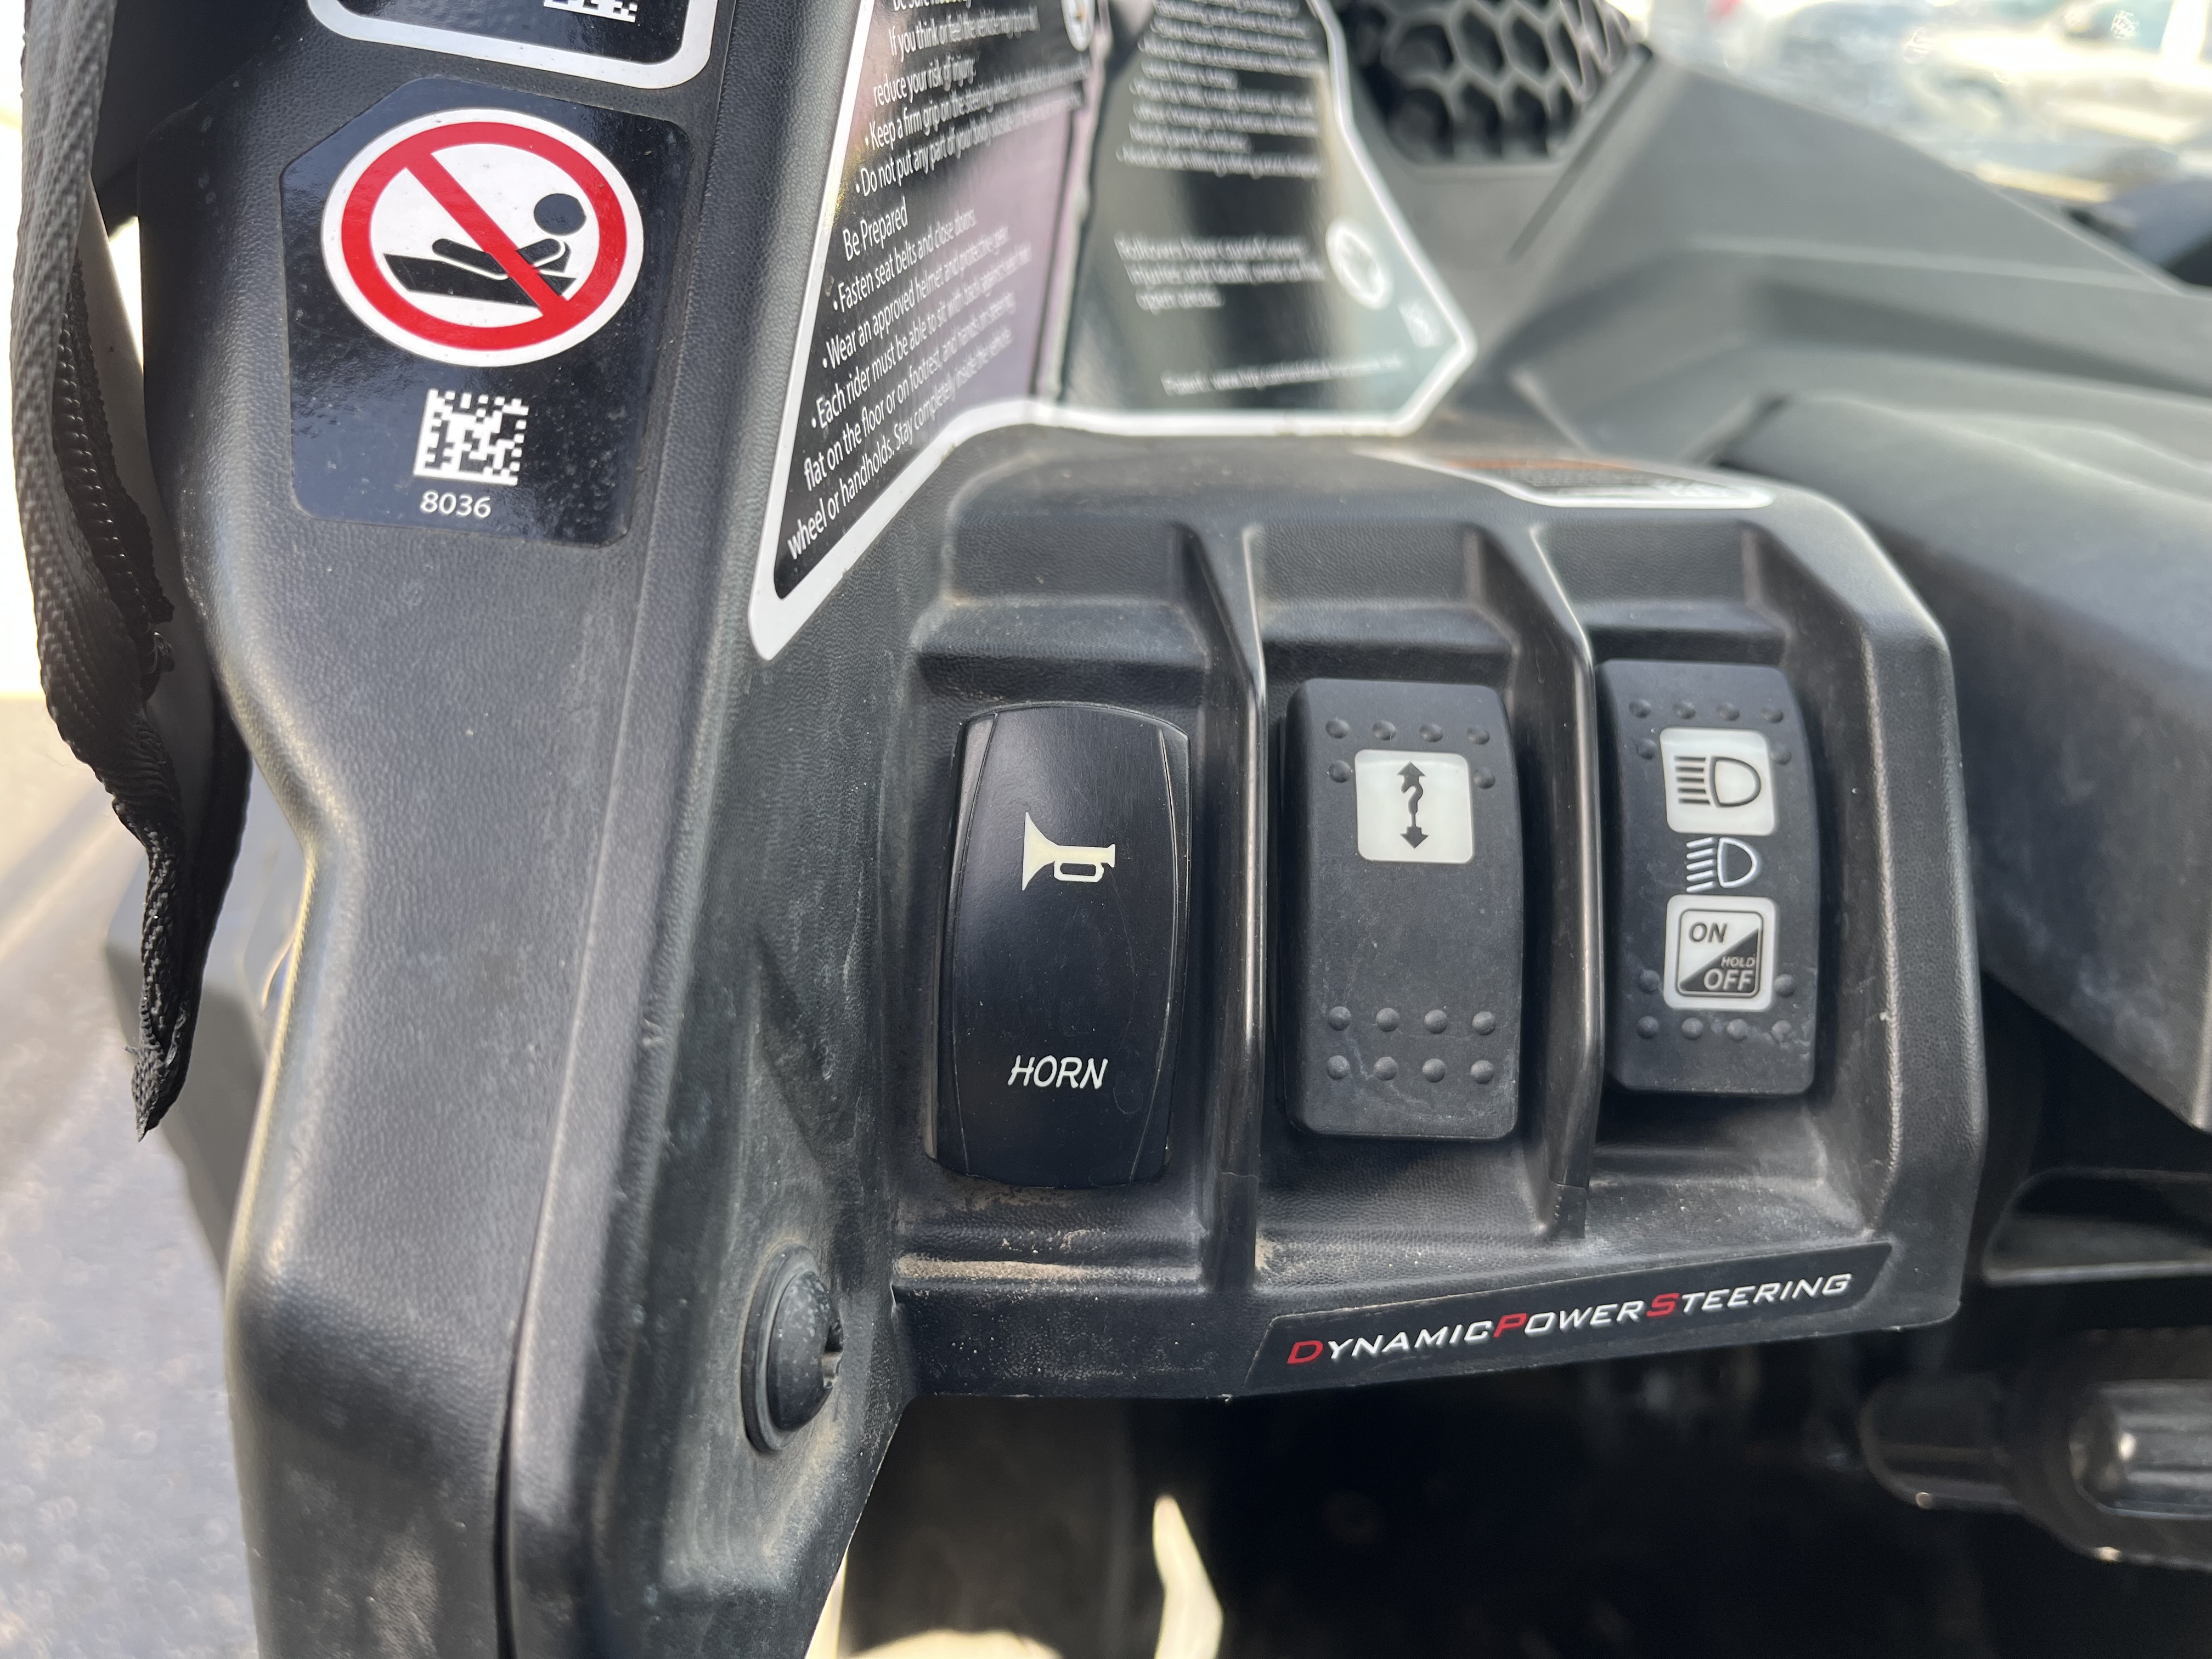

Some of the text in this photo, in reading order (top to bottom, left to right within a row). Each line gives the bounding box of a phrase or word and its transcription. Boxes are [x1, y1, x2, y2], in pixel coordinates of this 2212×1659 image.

[889, 26, 898, 56] If
[899, 31, 917, 63] you
[915, 18, 939, 49] think
[873, 73, 907, 108] reduce
[906, 70, 927, 104] your
[868, 119, 896, 151] Keep
[897, 118, 904, 139] a
[902, 104, 923, 137] firm
[922, 99, 939, 137] grip
[860, 166, 878, 198] Do
[878, 157, 896, 189] not
[895, 149, 913, 187] put
[913, 146, 929, 175] any
[929, 132, 947, 171] part
[843, 194, 909, 261] Be Prepared
[837, 271, 874, 314] Fasten
[874, 254, 895, 290] seat
[894, 240, 918, 275] belts
[917, 223, 934, 260] and
[825, 330, 857, 369] Wear
[857, 315, 872, 348] an
[872, 276, 916, 341] approved
[915, 262, 945, 303] helmet
[815, 383, 847, 430] Each
[846, 366, 872, 405] rider
[871, 345, 897, 383] must
[895, 334, 910, 362] be
[909, 314, 928, 351] able
[926, 310, 937, 335] to
[804, 451, 827, 492] flat
[827, 440, 844, 472] on
[842, 422, 862, 455] the
[861, 399, 884, 438] floor
[885, 393, 896, 415] or
[898, 381, 910, 404] on
[420, 490, 492, 519] 8036
[787, 498, 828, 560] wheel
[827, 490, 840, 521] or
[839, 434, 895, 507] handholds.
[893, 415, 914, 452] Stay
[1688, 922, 1728, 943] ON
[1703, 968, 1754, 991] OFF
[1720, 956, 1756, 969] HOLD
[1007, 1054, 1109, 1090] HORN
